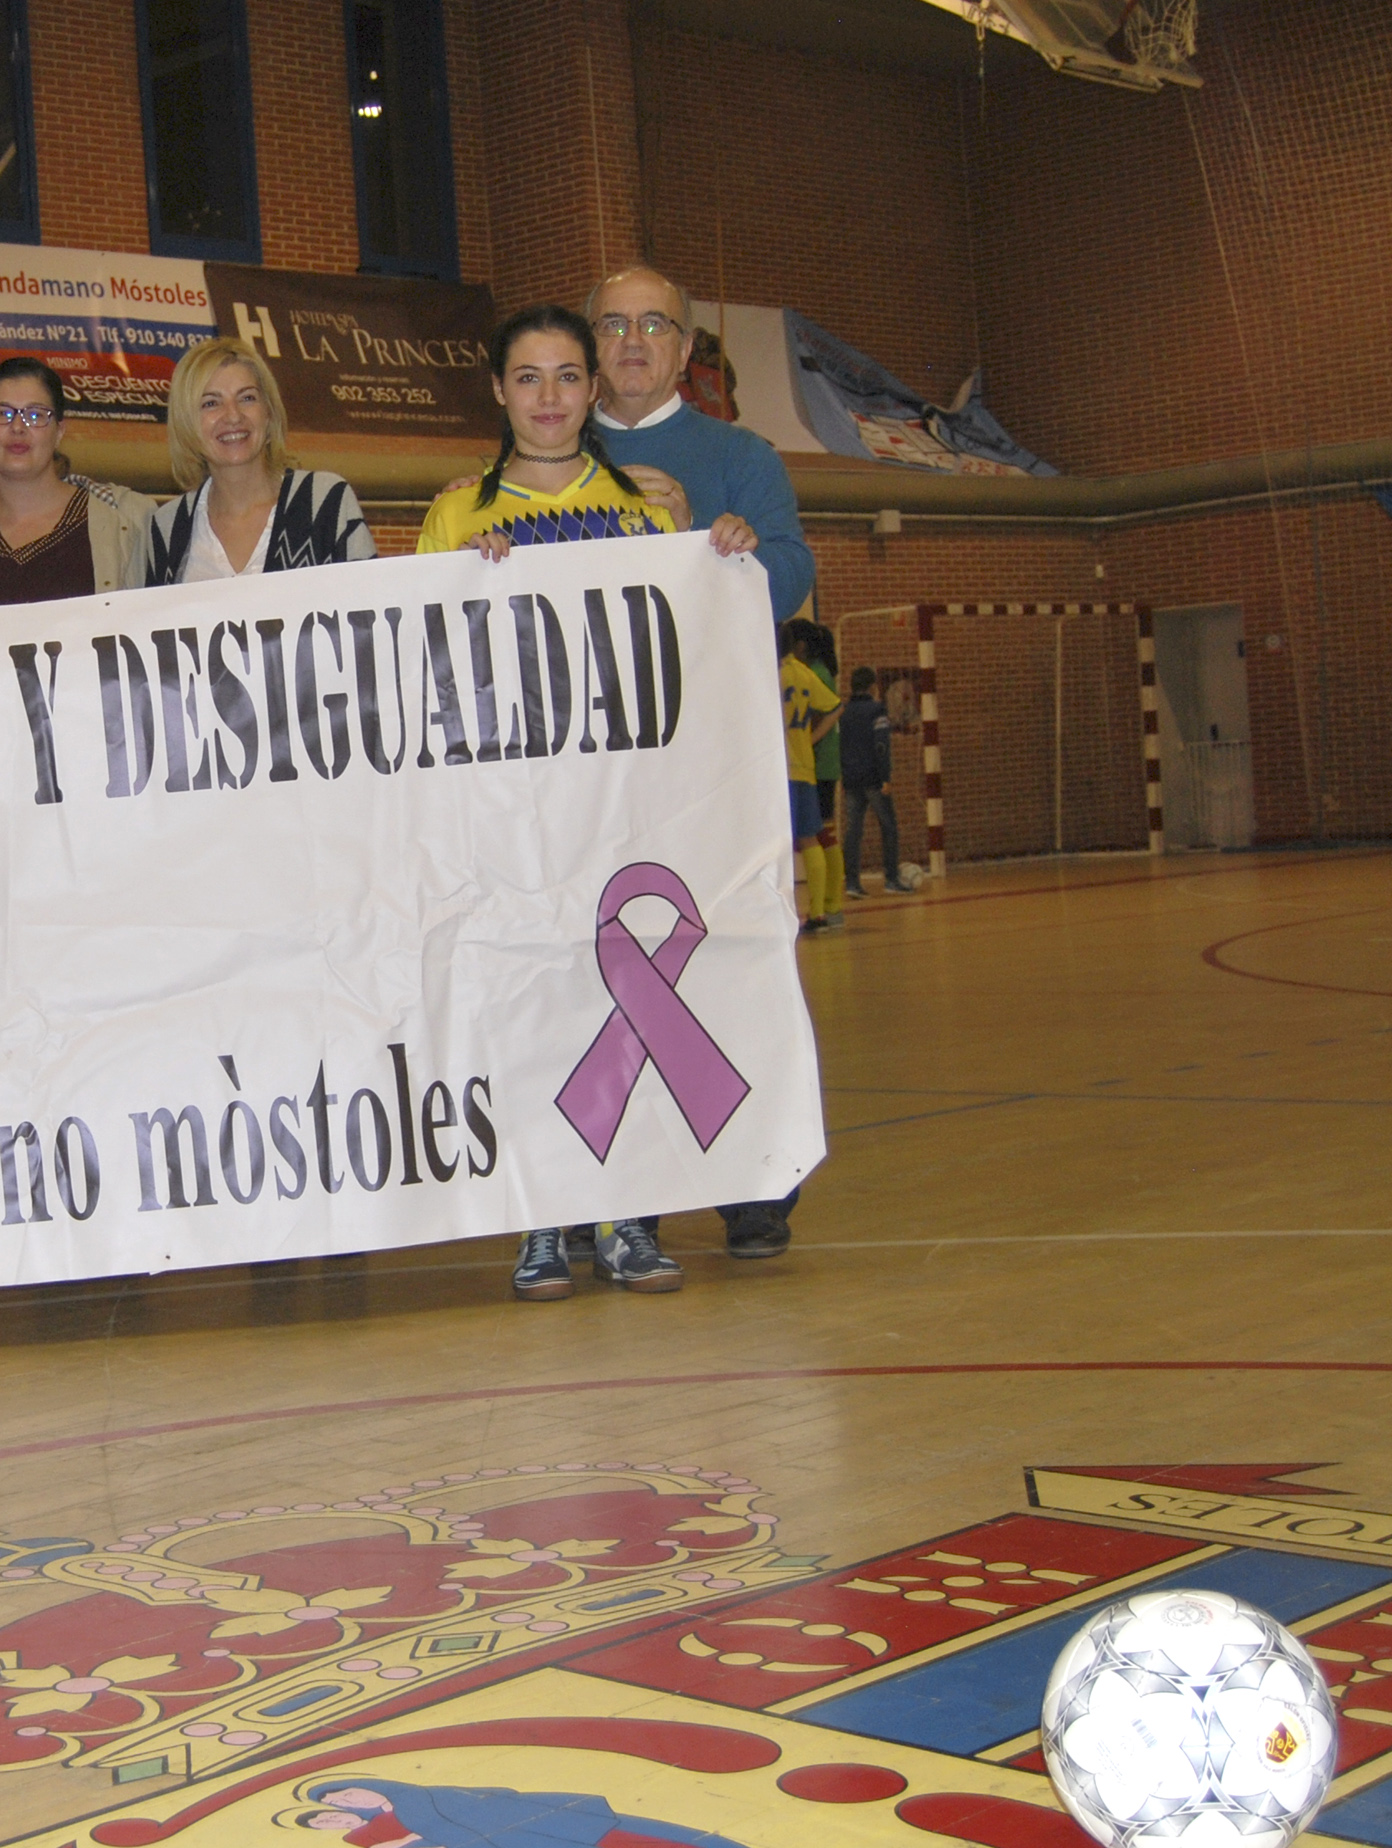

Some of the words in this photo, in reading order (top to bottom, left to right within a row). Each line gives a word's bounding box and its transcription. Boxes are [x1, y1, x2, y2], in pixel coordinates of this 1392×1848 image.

[110, 277, 208, 307] Móstoles
[97, 326, 126, 345] Tlf.
[127, 328, 156, 346] 910
[158, 330, 186, 348] 340
[293, 324, 340, 363] LA
[351, 328, 490, 368] PRINCESA
[70, 374, 172, 394] DESCUENTO
[331, 384, 368, 402] 902
[366, 387, 401, 403] 353
[401, 388, 437, 405] 252
[84, 389, 169, 407] ESPECIAL
[8, 641, 65, 805] Y
[91, 584, 682, 799] DESIGUALDAD
